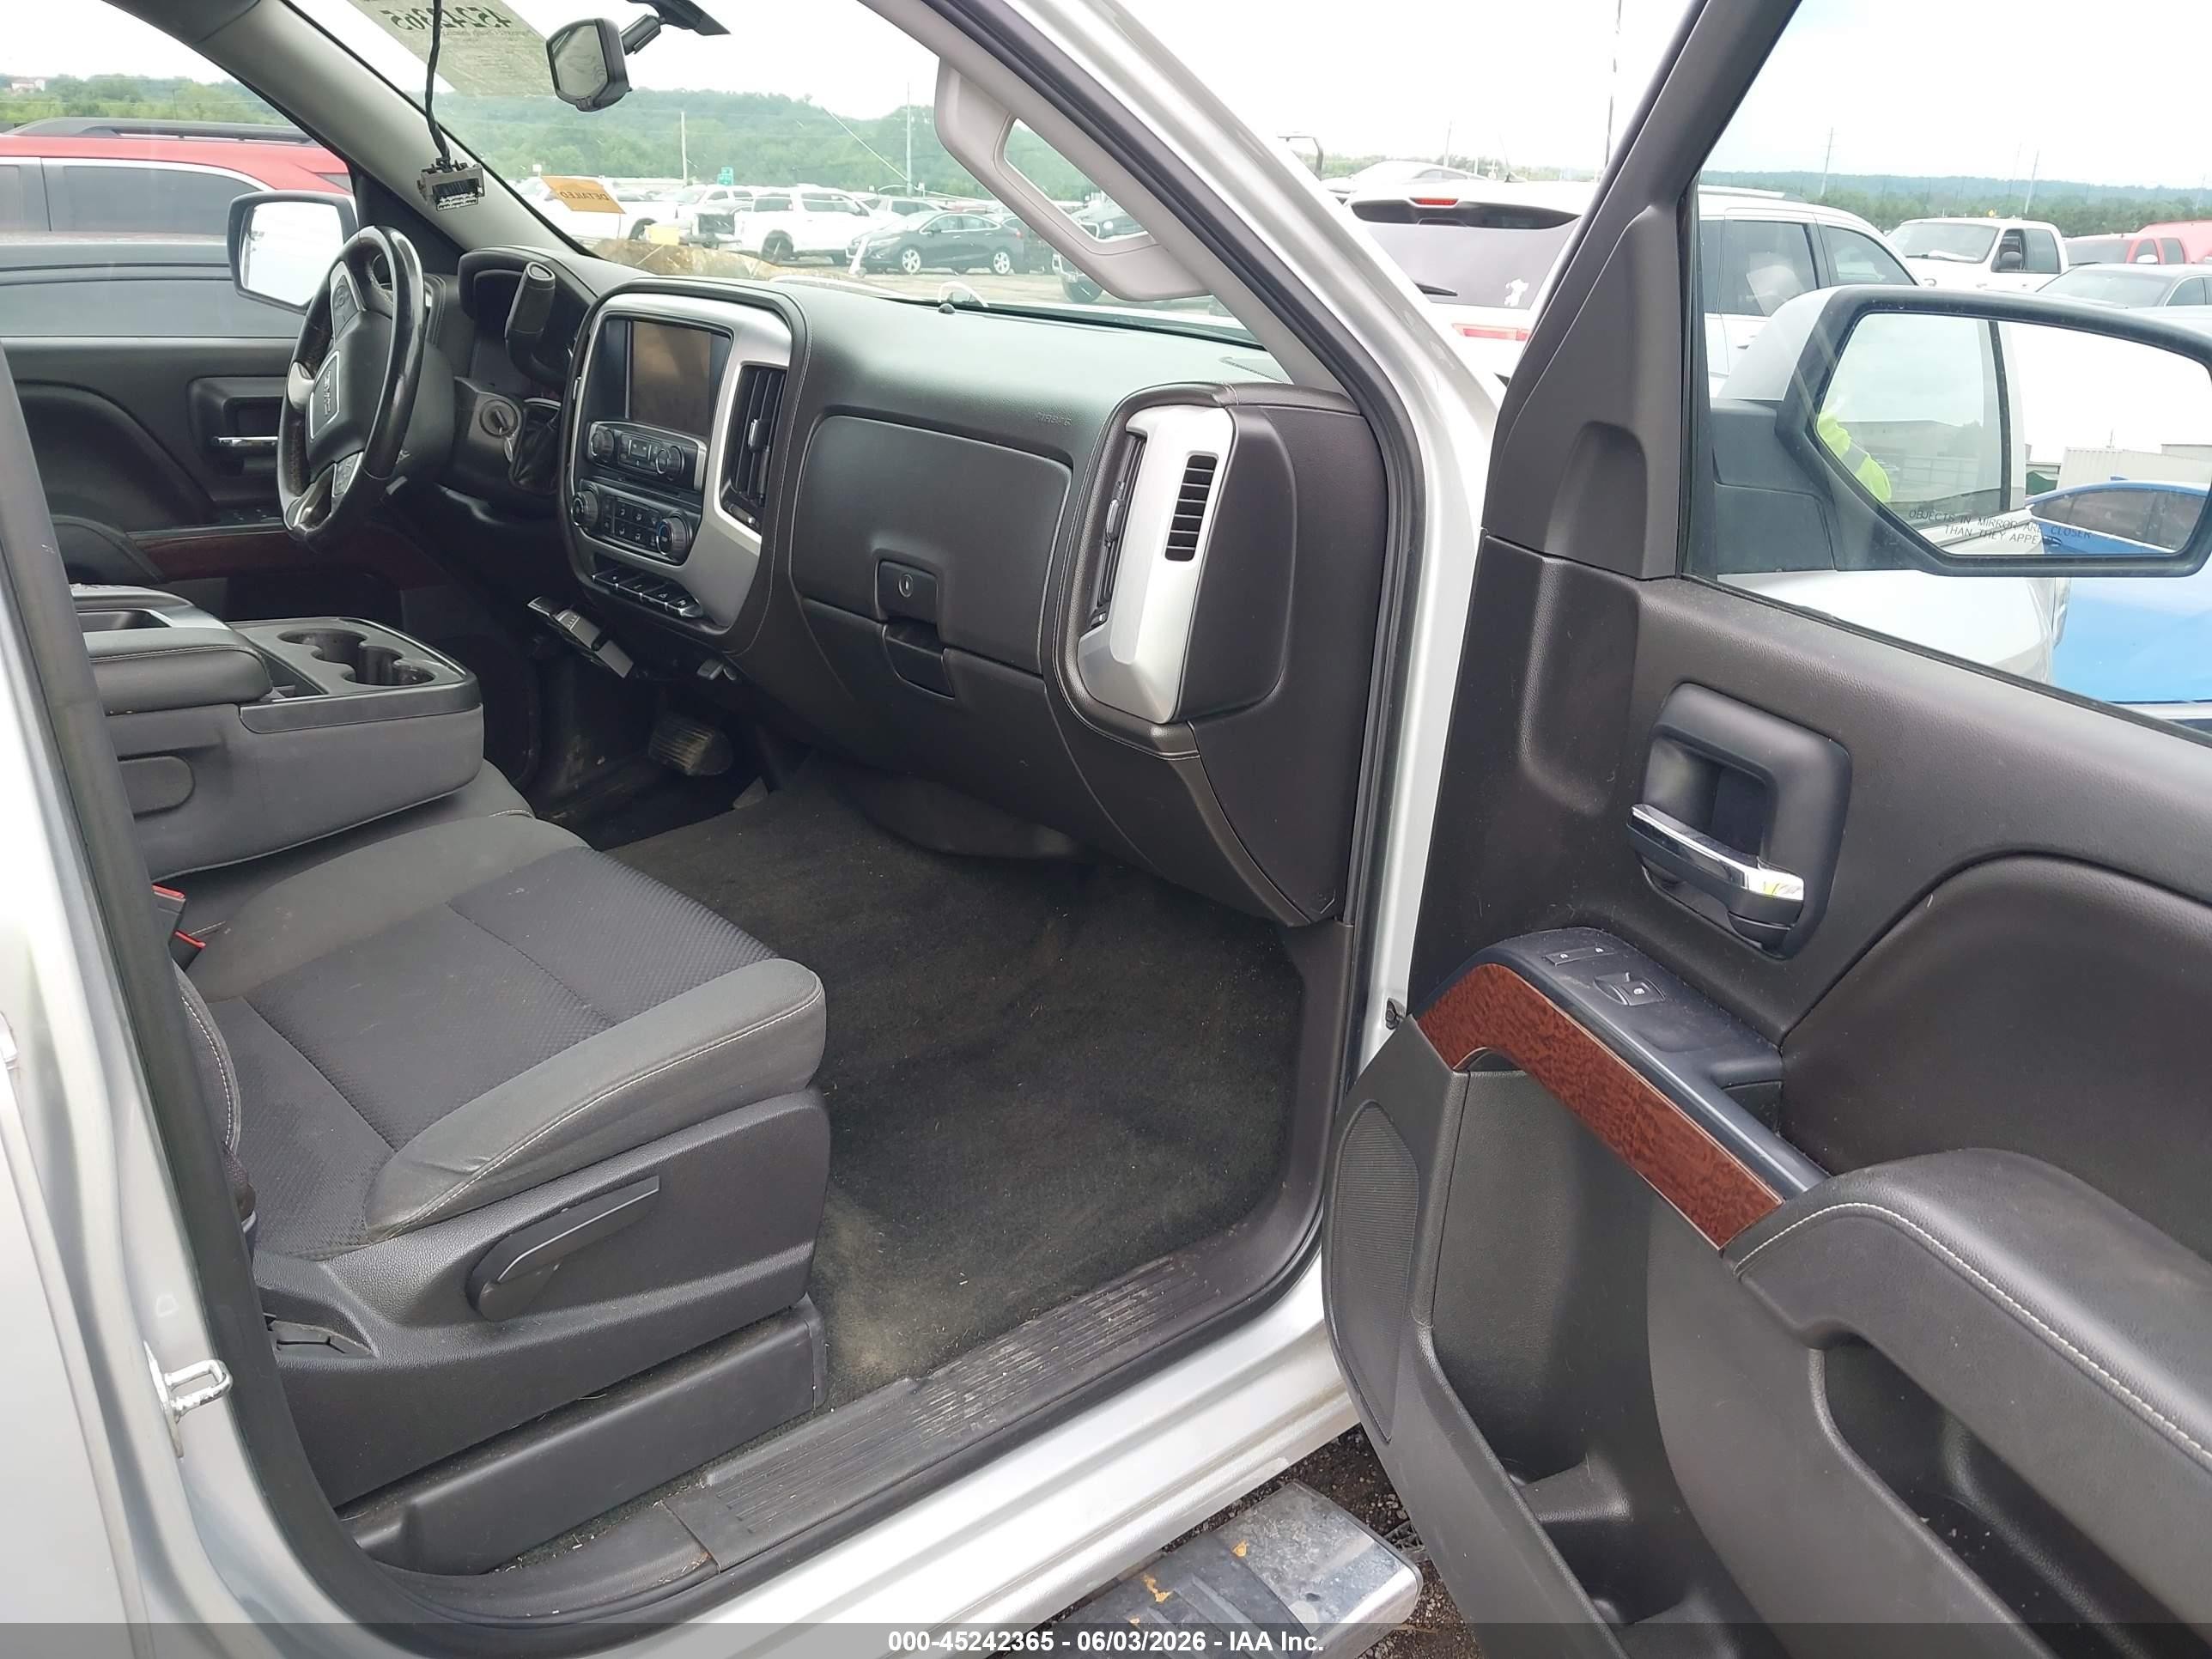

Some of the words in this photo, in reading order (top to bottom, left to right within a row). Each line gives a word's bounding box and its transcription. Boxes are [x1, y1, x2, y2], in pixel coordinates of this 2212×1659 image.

[1909, 509, 1956, 522] OBJECTS
[1960, 514, 1971, 525] IN
[1978, 517, 2019, 530] MIRROR
[2023, 523, 2042, 533] ARE
[2050, 526, 2092, 539] CLOSER
[1944, 525, 1973, 537] THAN
[1979, 529, 2006, 539] THEY
